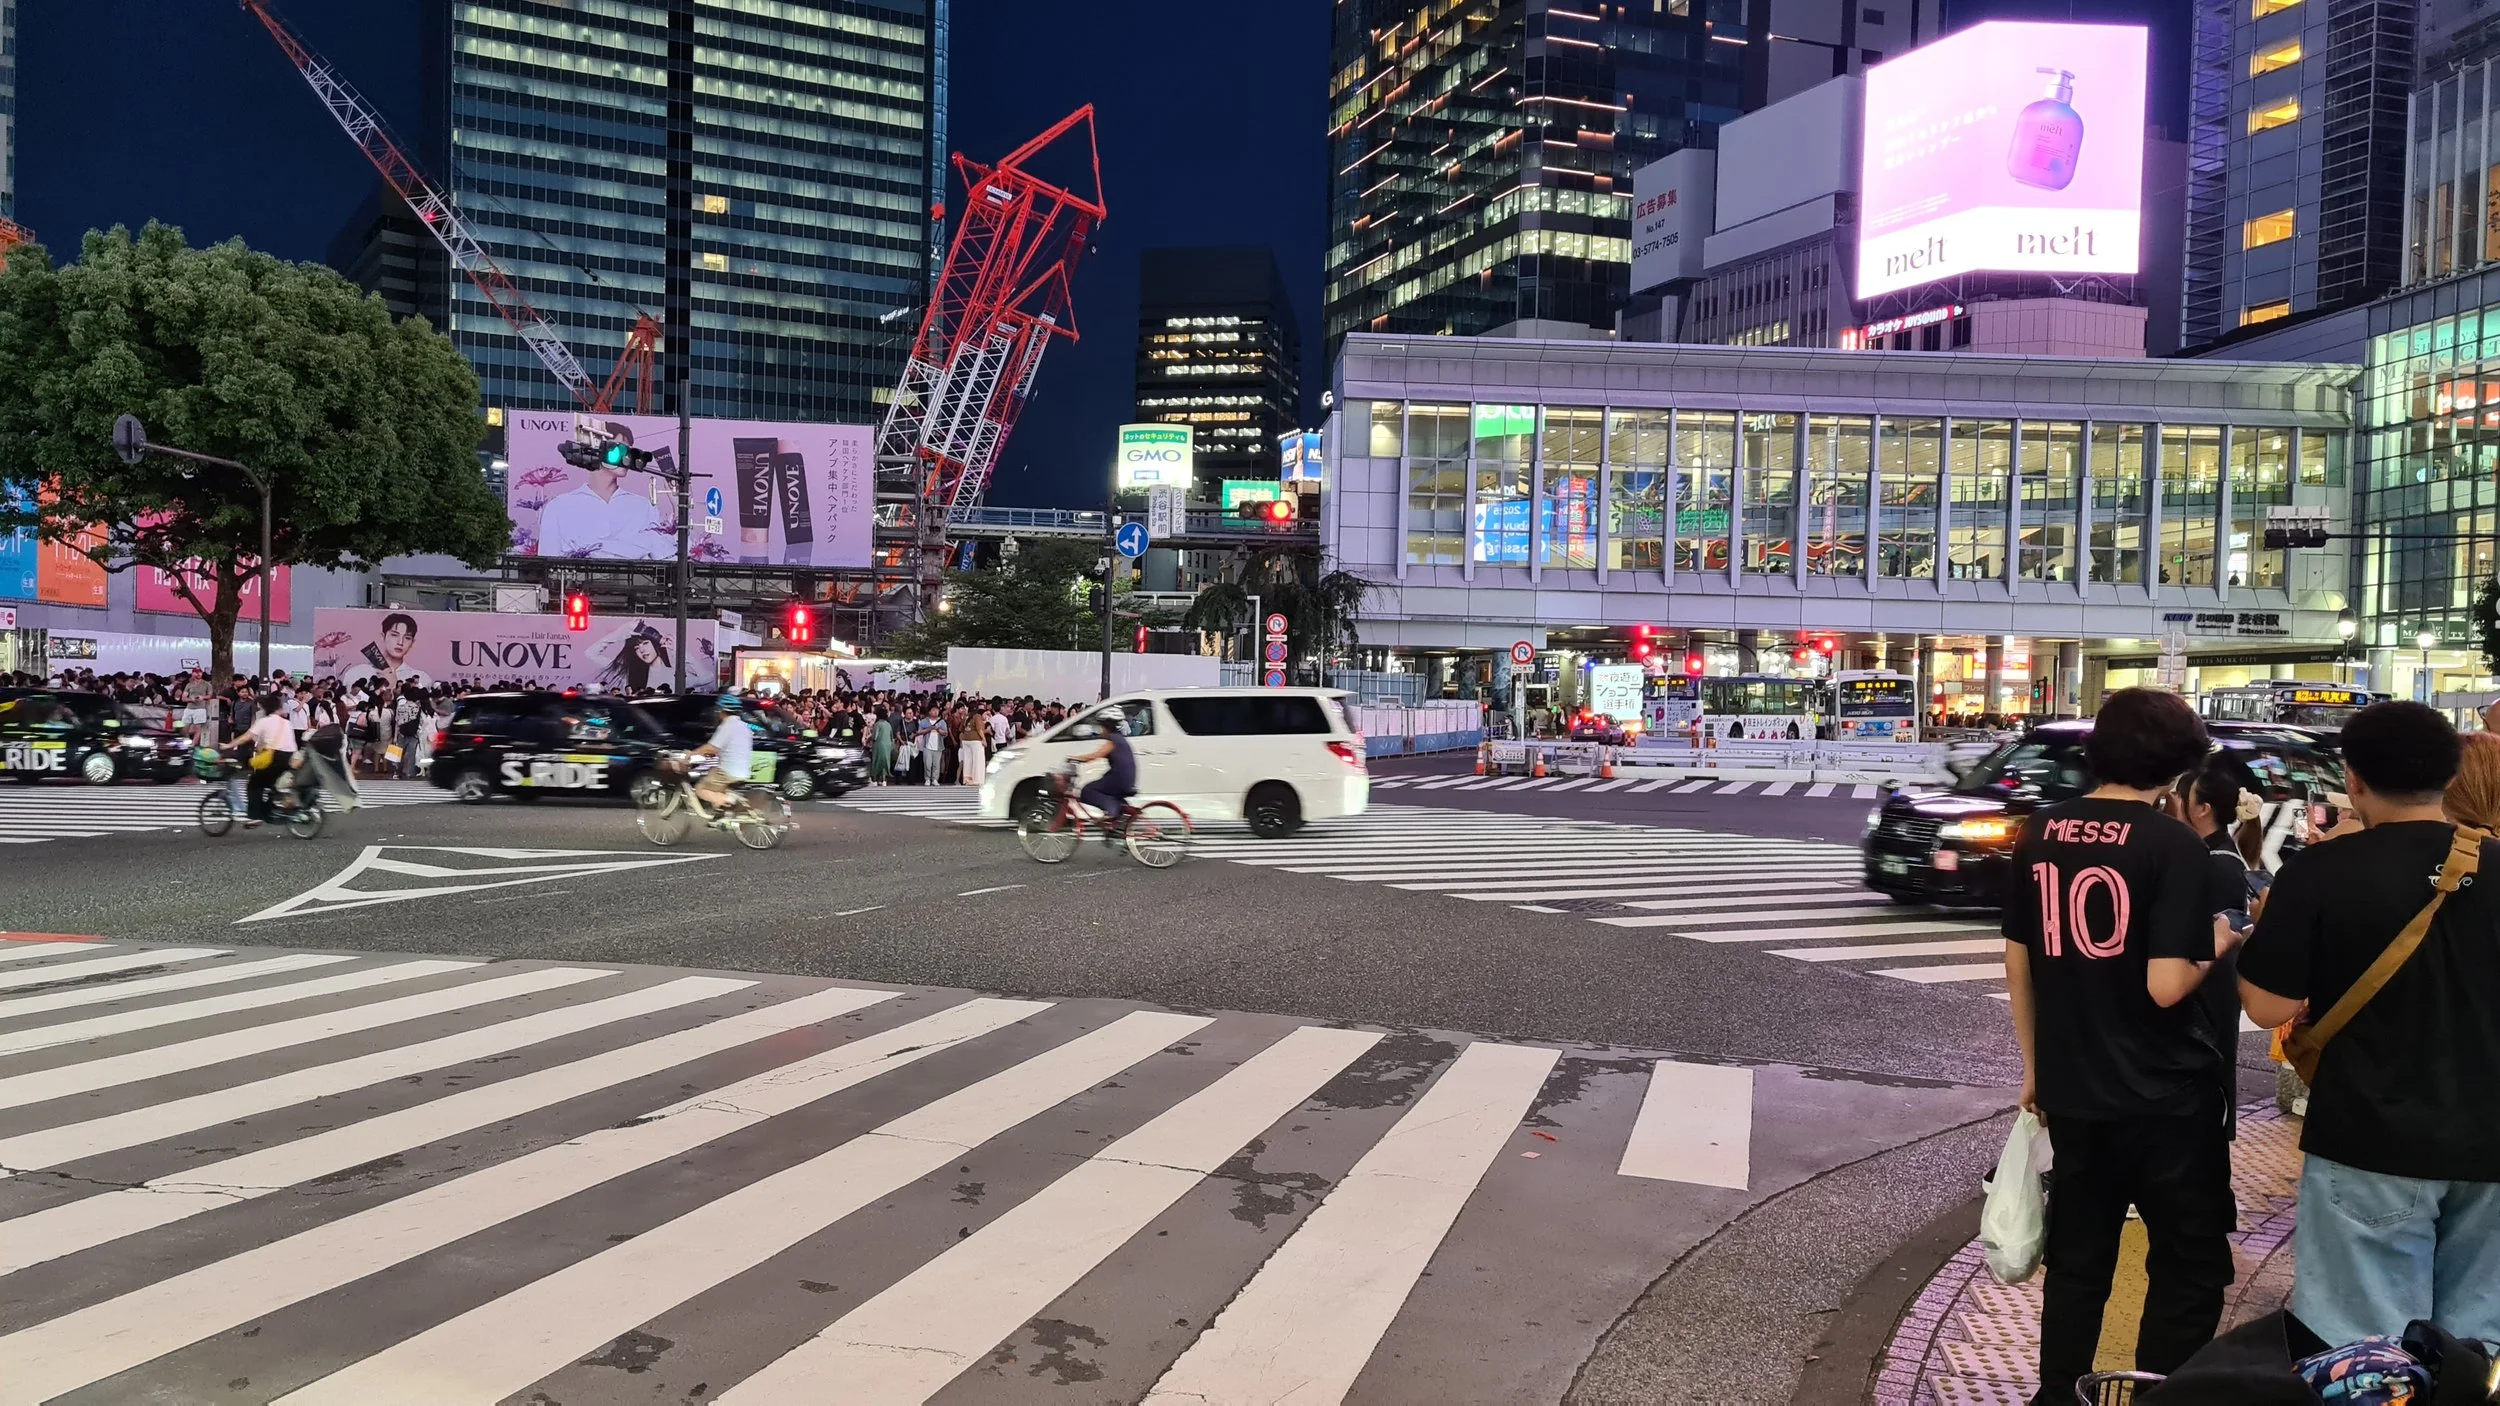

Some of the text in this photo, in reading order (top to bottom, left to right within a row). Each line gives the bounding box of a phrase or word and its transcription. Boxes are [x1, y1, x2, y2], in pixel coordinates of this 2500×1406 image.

[2040, 123, 2063, 136] melt
[1636, 189, 1677, 219] 広告募集
[1633, 232, 1679, 259] 03-5774-7505
[2017, 226, 2098, 256] melt
[1886, 235, 1948, 277] melt
[1868, 318, 1903, 337] カラオケ
[1904, 307, 1949, 329] JOYSOUND
[520, 419, 569, 432] UNOVE
[1127, 449, 1182, 462] GMO
[752, 452, 770, 516] UNOVE
[785, 464, 800, 529] UNOVE
[827, 438, 838, 543] アノブ集中ヘアパック
[2237, 613, 2280, 626] 渋谷駅
[531, 631, 546, 640] Hair
[547, 632, 571, 642] Fantasy
[451, 641, 572, 669] UNOVE
[1596, 683, 1642, 697] ショコラ
[500, 760, 609, 789] S.RIDE
[2043, 818, 2132, 845] MESSI
[2032, 862, 2130, 959] 10
